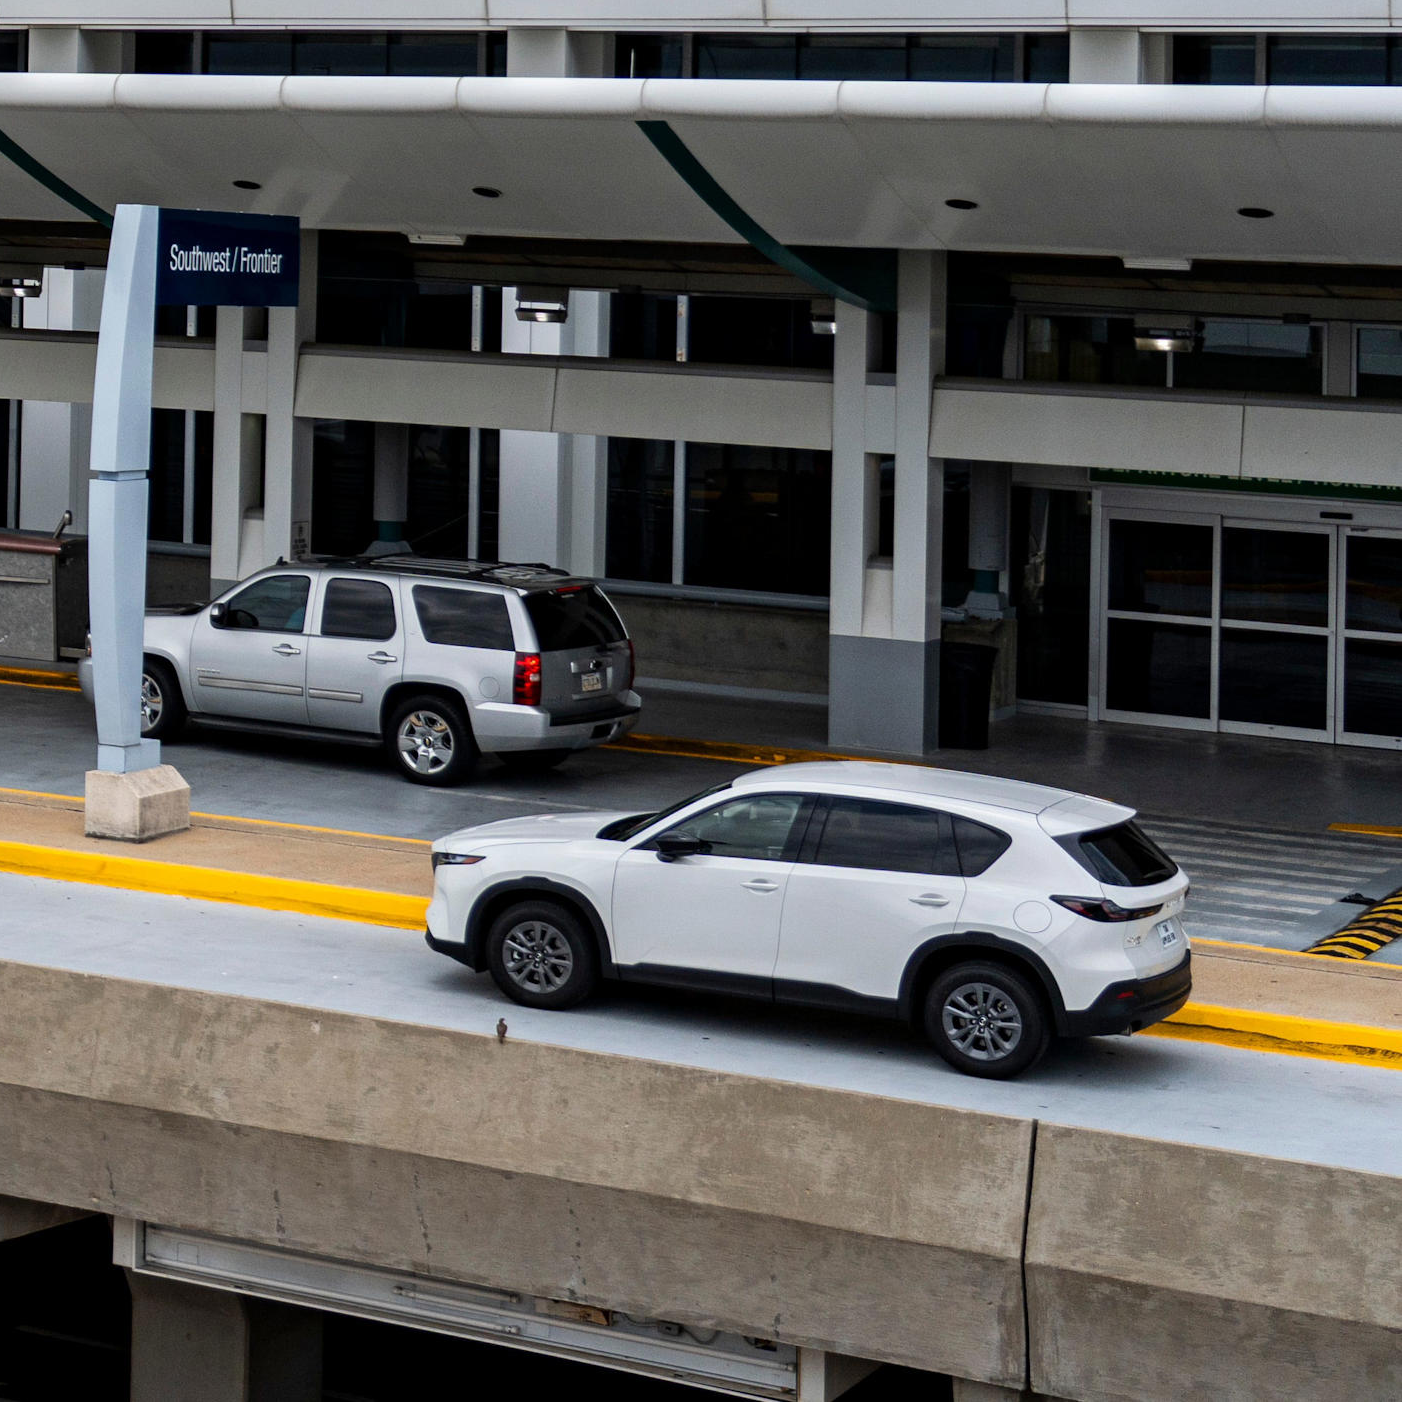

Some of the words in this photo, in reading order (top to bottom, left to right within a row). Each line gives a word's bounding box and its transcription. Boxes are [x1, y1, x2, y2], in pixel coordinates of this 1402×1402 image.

[170, 244, 230, 272] Southwest
[232, 247, 238, 273] /
[240, 247, 283, 274] Frontier
